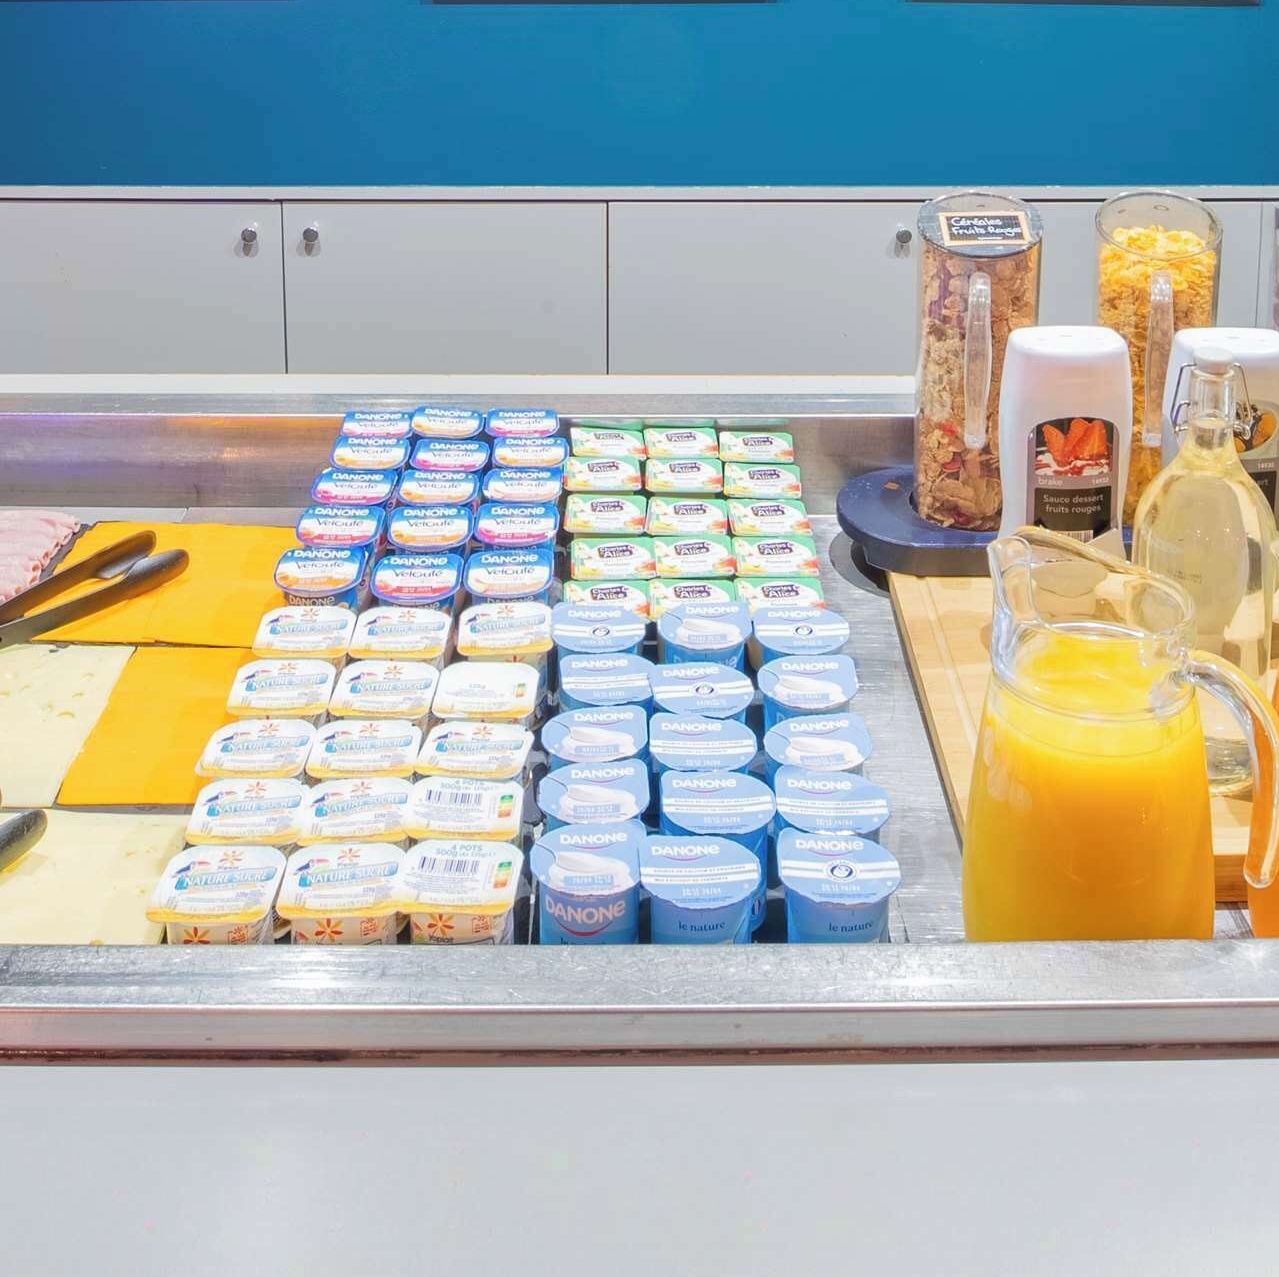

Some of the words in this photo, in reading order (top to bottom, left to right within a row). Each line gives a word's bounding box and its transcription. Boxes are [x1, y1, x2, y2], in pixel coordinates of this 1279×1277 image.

[952, 226, 986, 235] Fruits
[354, 412, 402, 420] DANONE
[424, 408, 471, 417] DANONE
[348, 437, 398, 446] DANONE
[429, 442, 479, 451] DANONE
[505, 437, 555, 446] DANONE
[332, 472, 385, 481] DANONE
[415, 472, 467, 481] DANONE
[499, 471, 552, 480] DANONE
[1043, 494, 1071, 503] Sauce
[1072, 494, 1104, 503] dessert
[314, 507, 370, 517] DANONE
[403, 508, 458, 517] DANONE
[491, 506, 546, 516] DANONE
[1045, 504, 1070, 513] fruits
[1071, 505, 1101, 515] rouges
[294, 549, 351, 559] DANONE
[603, 550, 633, 558] Alice
[681, 547, 709, 555] Alice
[764, 547, 792, 555] Alice
[390, 556, 448, 567] DANONE
[481, 554, 539, 564] DANONE
[597, 591, 627, 600] Alice
[680, 590, 710, 598] Alice
[769, 590, 799, 598] Alice
[568, 609, 621, 619] DANONE
[685, 605, 739, 616] DANONE
[768, 610, 821, 619] DANONE
[572, 659, 628, 670] DANONE
[782, 661, 840, 672] DANONE
[662, 665, 720, 678] DANONE
[574, 711, 634, 723] DANONE
[661, 721, 722, 733] DANONE
[789, 718, 850, 733] DANONE
[570, 766, 636, 779] DANONE
[672, 777, 737, 789] DANONE
[787, 778, 852, 791] DANONE
[559, 832, 628, 845] DANONE
[795, 839, 865, 851] DANONE
[651, 844, 720, 857] DANONE
[187, 874, 228, 887] NATURE
[309, 869, 352, 884] NATURE
[544, 894, 627, 925] DANONE
[678, 921, 689, 931] le
[690, 921, 726, 933] nature
[828, 922, 839, 933] le
